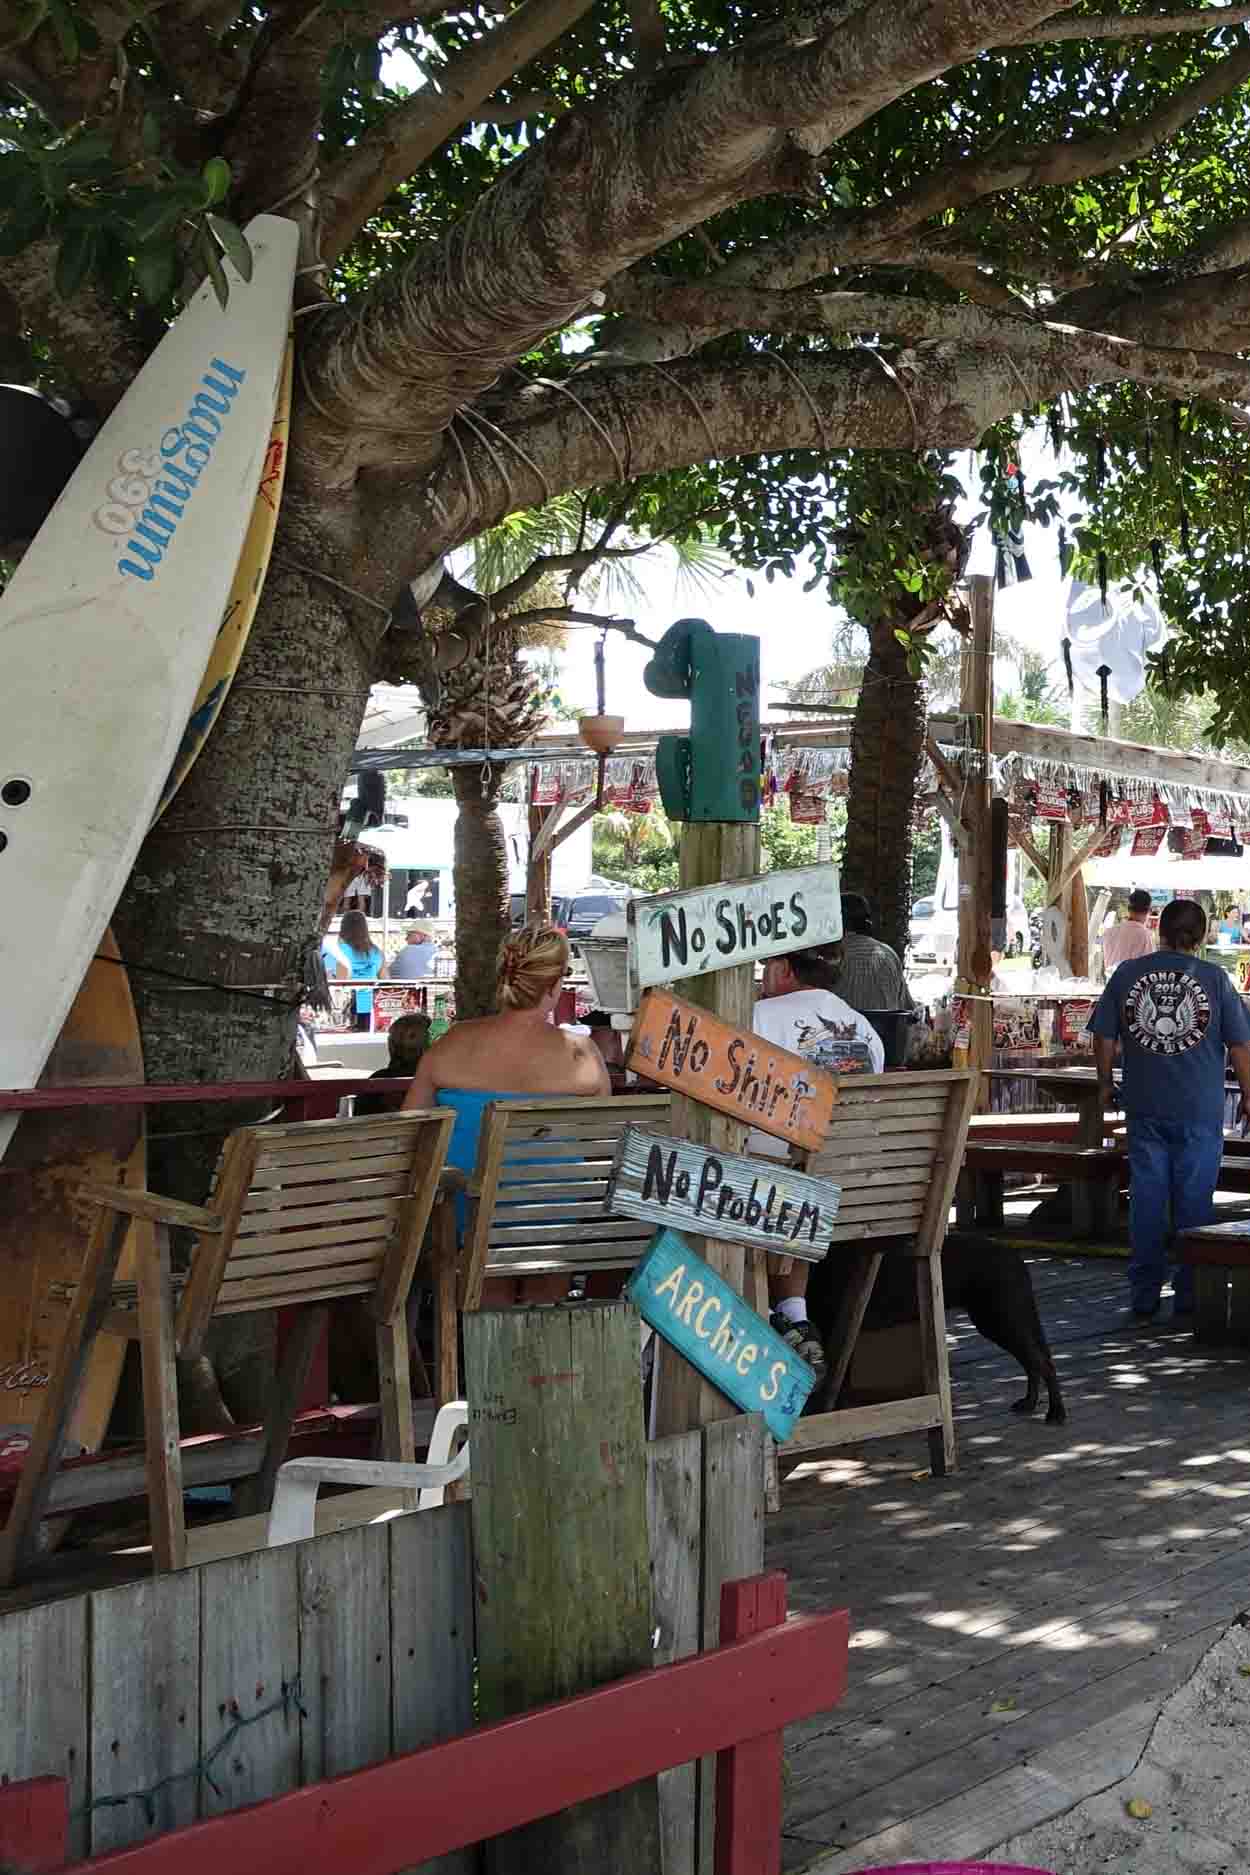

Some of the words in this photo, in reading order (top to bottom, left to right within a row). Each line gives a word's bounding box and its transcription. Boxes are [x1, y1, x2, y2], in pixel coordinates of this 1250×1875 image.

[660, 906, 706, 968] No
[1126, 972, 1176, 1006] DAYTONA
[1179, 974, 1209, 1011] BEACH
[1154, 983, 1182, 994] 2014
[657, 1007, 710, 1079] No
[640, 1143, 691, 1208] No
